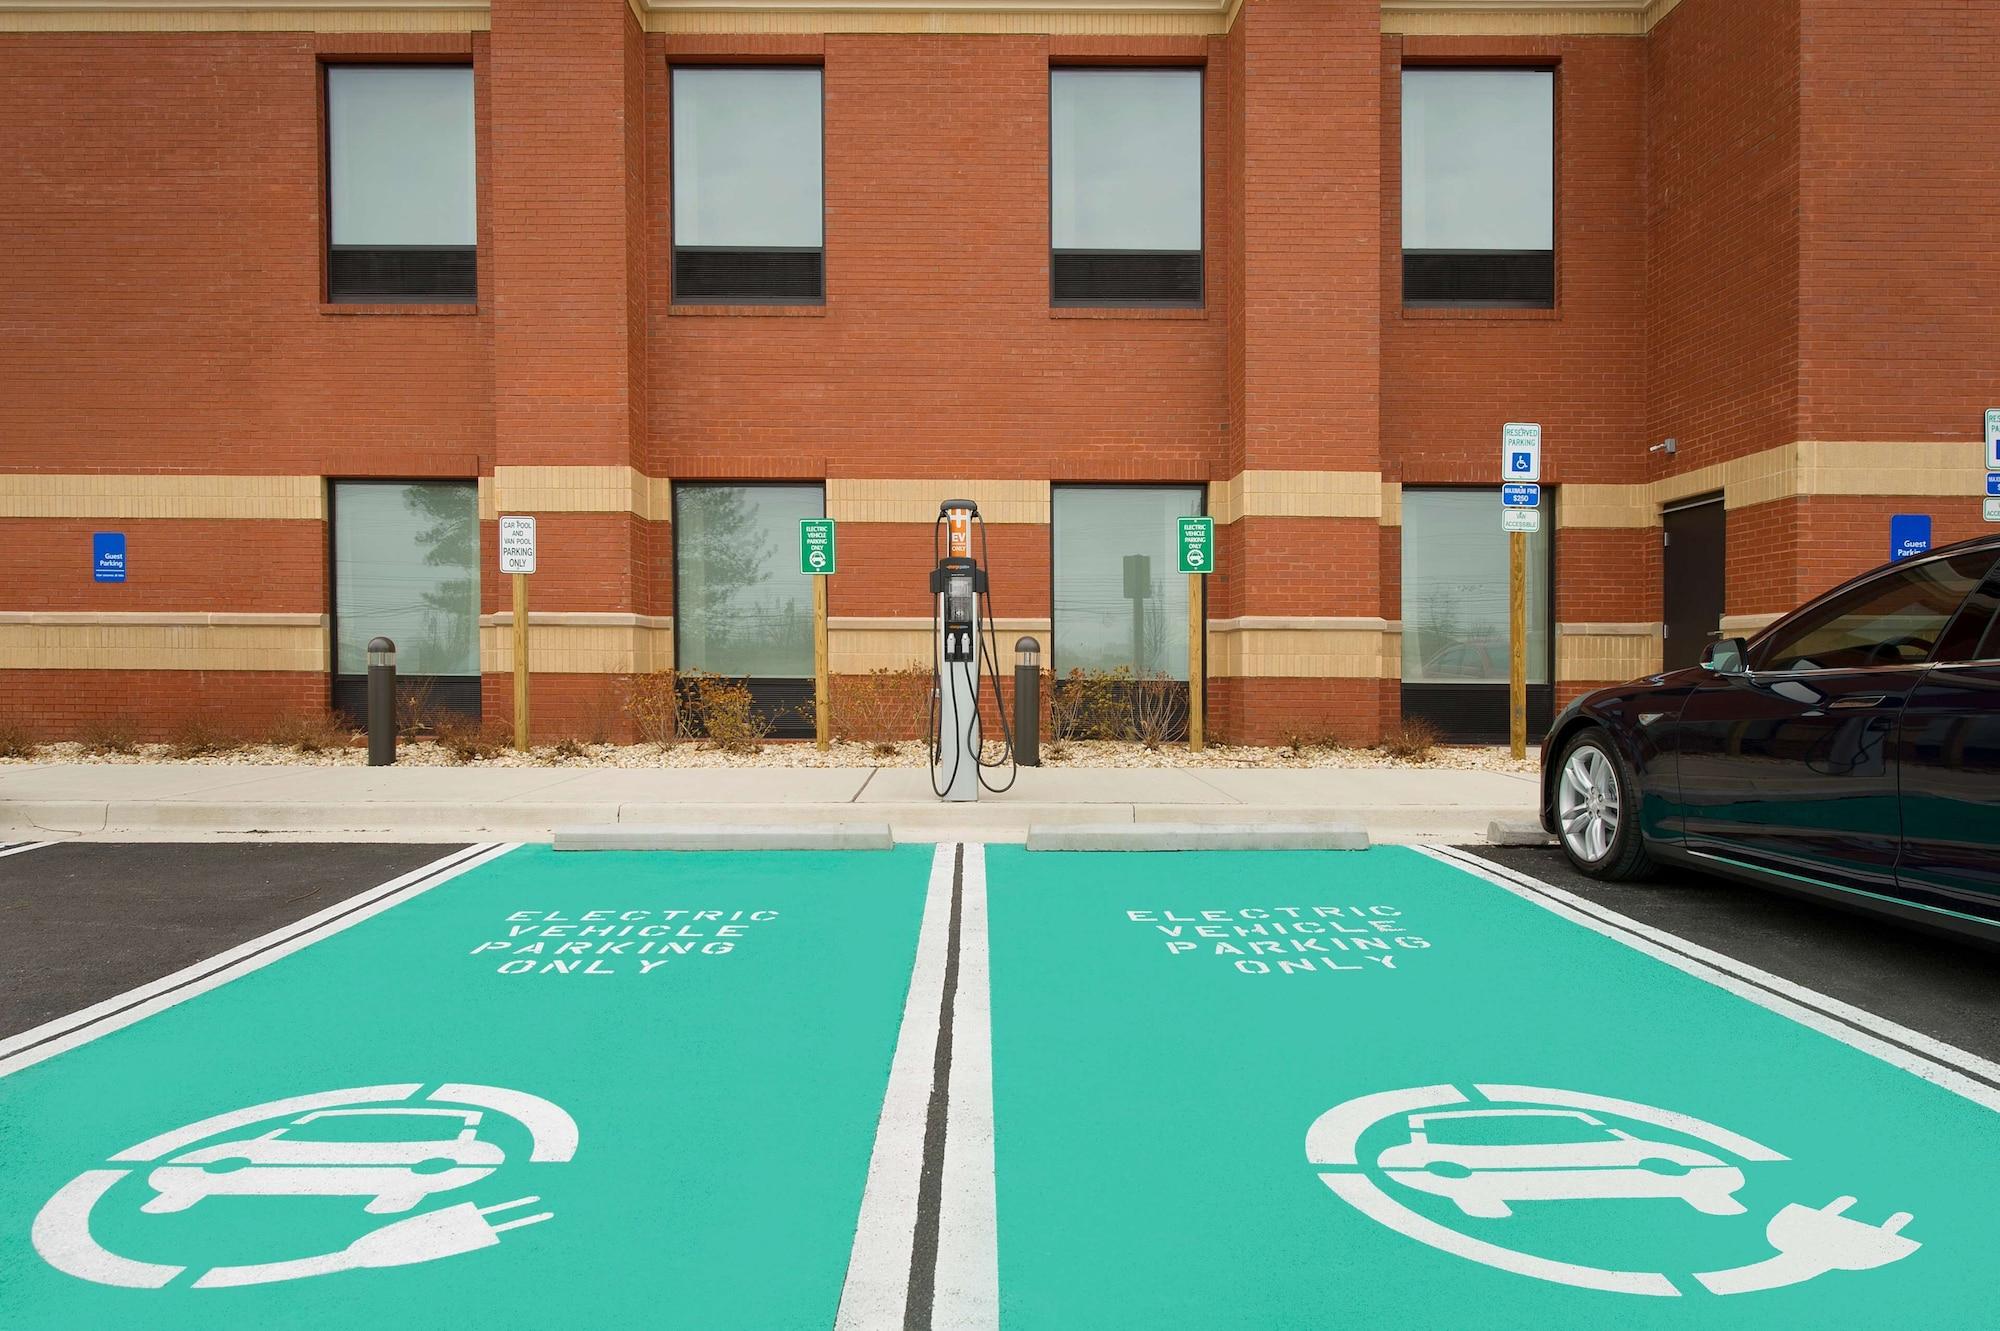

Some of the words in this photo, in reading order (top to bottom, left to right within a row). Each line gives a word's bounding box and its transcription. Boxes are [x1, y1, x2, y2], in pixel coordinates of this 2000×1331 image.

[1506, 429, 1537, 437] RESERVED
[1508, 438, 1535, 446] PARKING
[516, 521, 532, 529] POOL
[951, 532, 966, 542] EV
[1903, 540, 1927, 548] Guest
[104, 552, 123, 560] Guest
[503, 547, 532, 557] PARKING
[99, 560, 123, 568] Parking
[509, 558, 527, 568] ONLY
[505, 910, 780, 922] ELECTRIC
[1126, 905, 1402, 922] ELECTRIC
[508, 925, 750, 937] VEHICLE
[1156, 920, 1407, 937] VEHICLE
[469, 941, 735, 955] PARKING
[1165, 936, 1431, 955] PARKING
[496, 959, 669, 974] ONLY
[1234, 955, 1397, 974] ONLY
